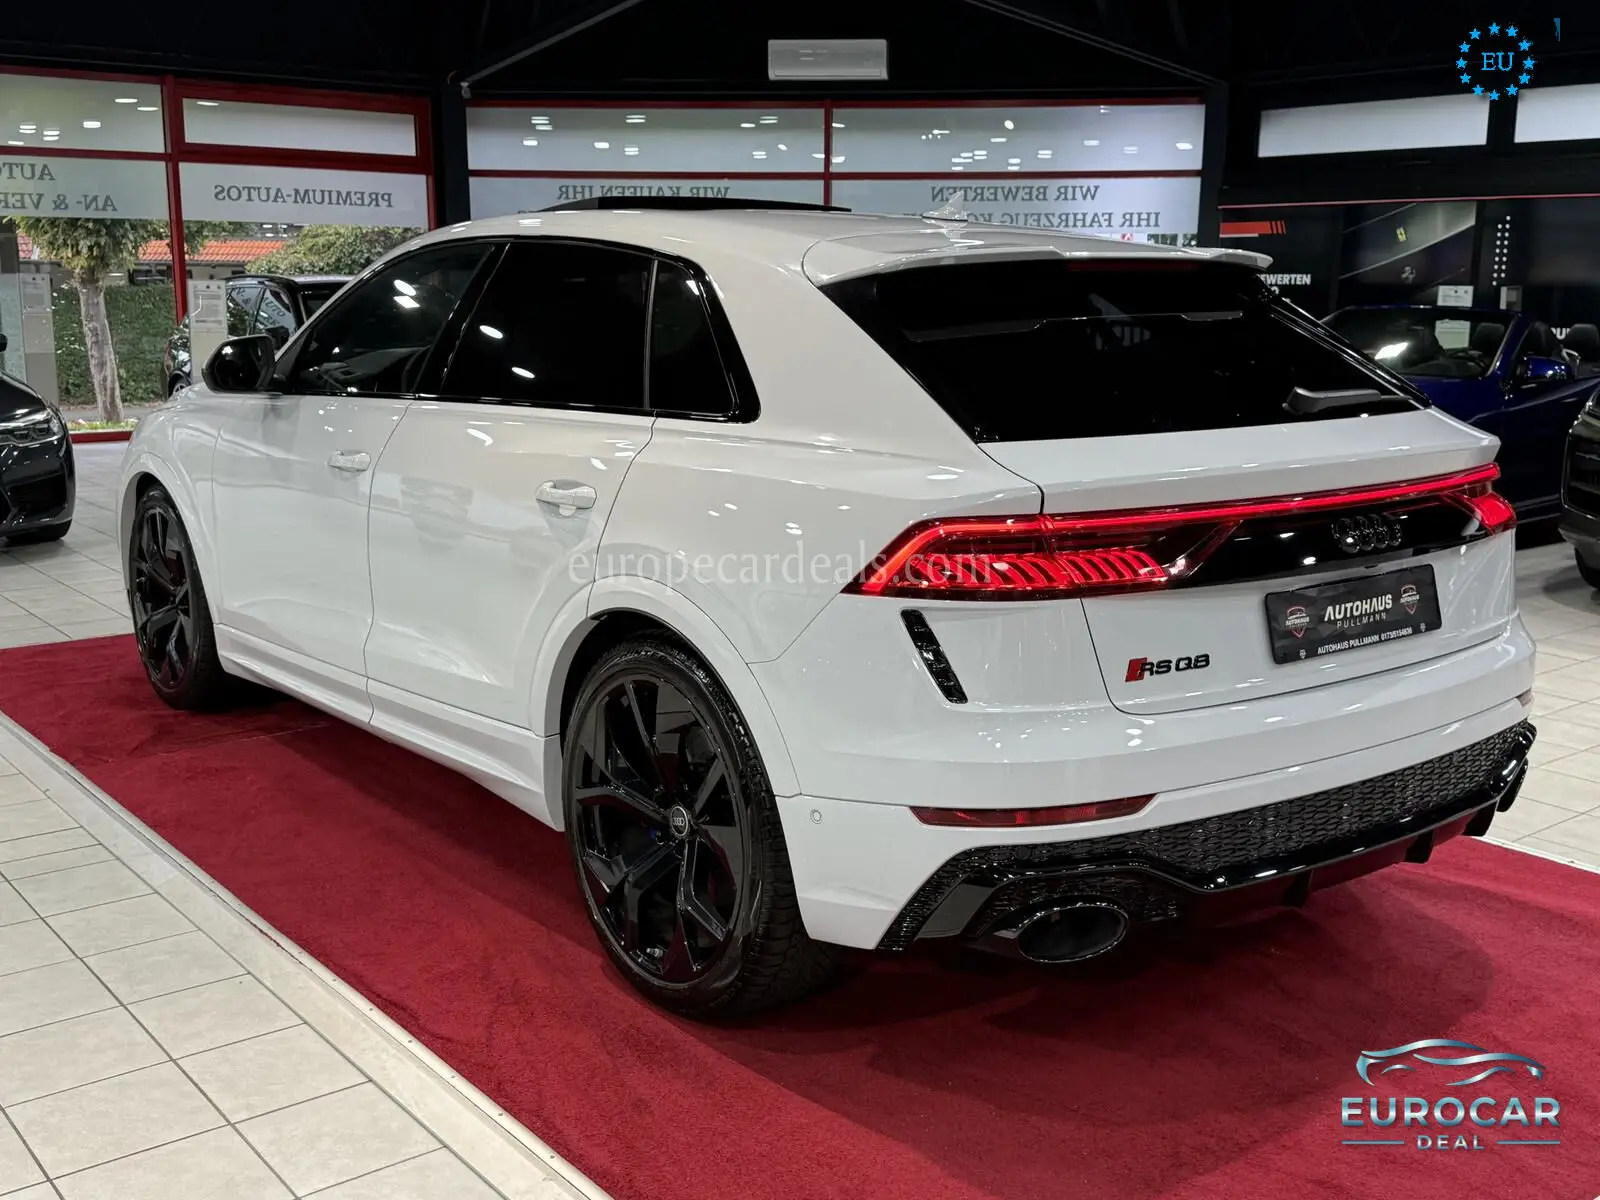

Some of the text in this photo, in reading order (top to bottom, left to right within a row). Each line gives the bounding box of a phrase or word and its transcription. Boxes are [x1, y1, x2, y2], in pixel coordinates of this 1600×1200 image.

[1324, 594, 1393, 622] AUTOHAUS
[1336, 612, 1387, 630] PULLMANN
[1317, 640, 1349, 655] AUTOHAUS
[1349, 634, 1380, 647] PULLMANN
